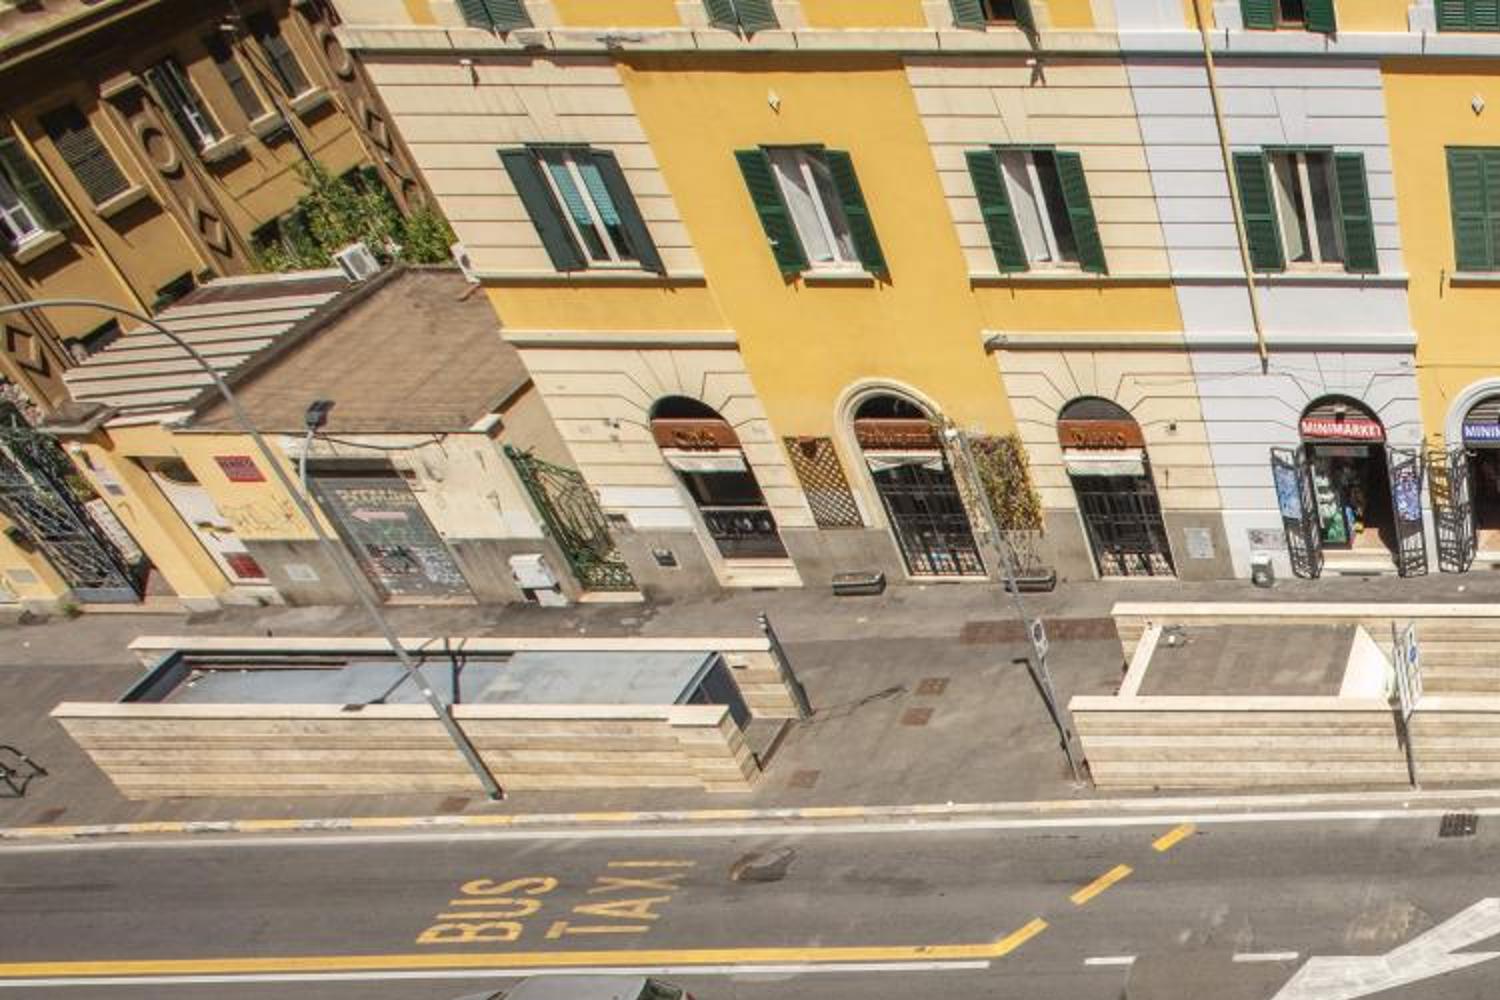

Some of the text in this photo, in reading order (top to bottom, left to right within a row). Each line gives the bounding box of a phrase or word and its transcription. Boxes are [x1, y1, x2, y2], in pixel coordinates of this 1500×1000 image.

[1302, 421, 1381, 437] MINIMARKET
[415, 876, 559, 944] BUS
[544, 859, 697, 940] TAXI
